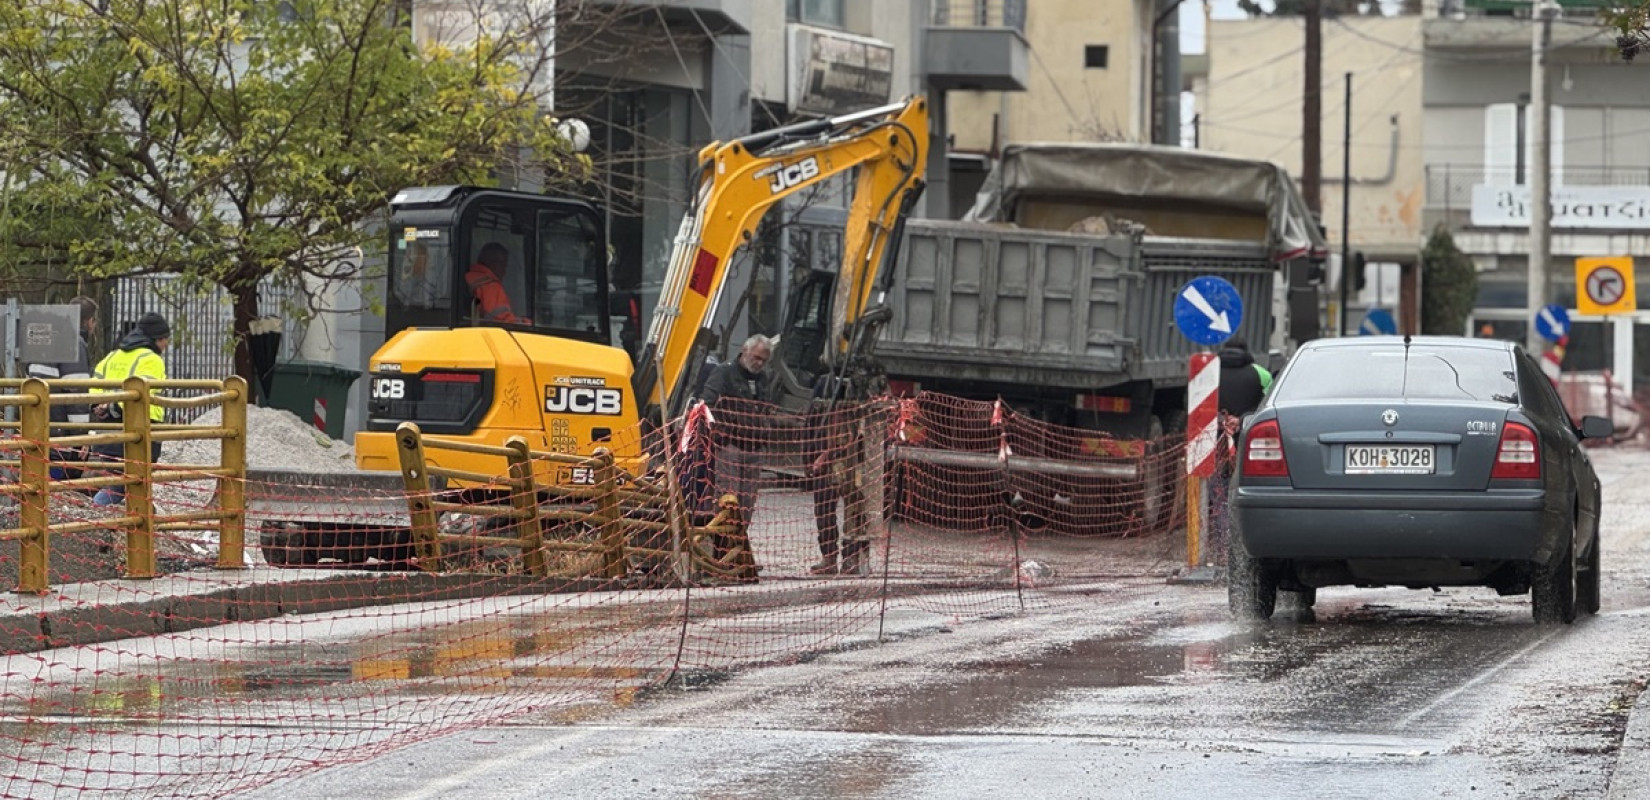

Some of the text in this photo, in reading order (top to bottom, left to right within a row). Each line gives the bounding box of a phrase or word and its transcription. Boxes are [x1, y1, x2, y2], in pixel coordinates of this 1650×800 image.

[771, 157, 819, 193] JCB
[373, 379, 404, 398] JCB
[571, 377, 605, 385] UNITRACK
[546, 387, 621, 414] JCB
[1390, 448, 1431, 467] 3028
